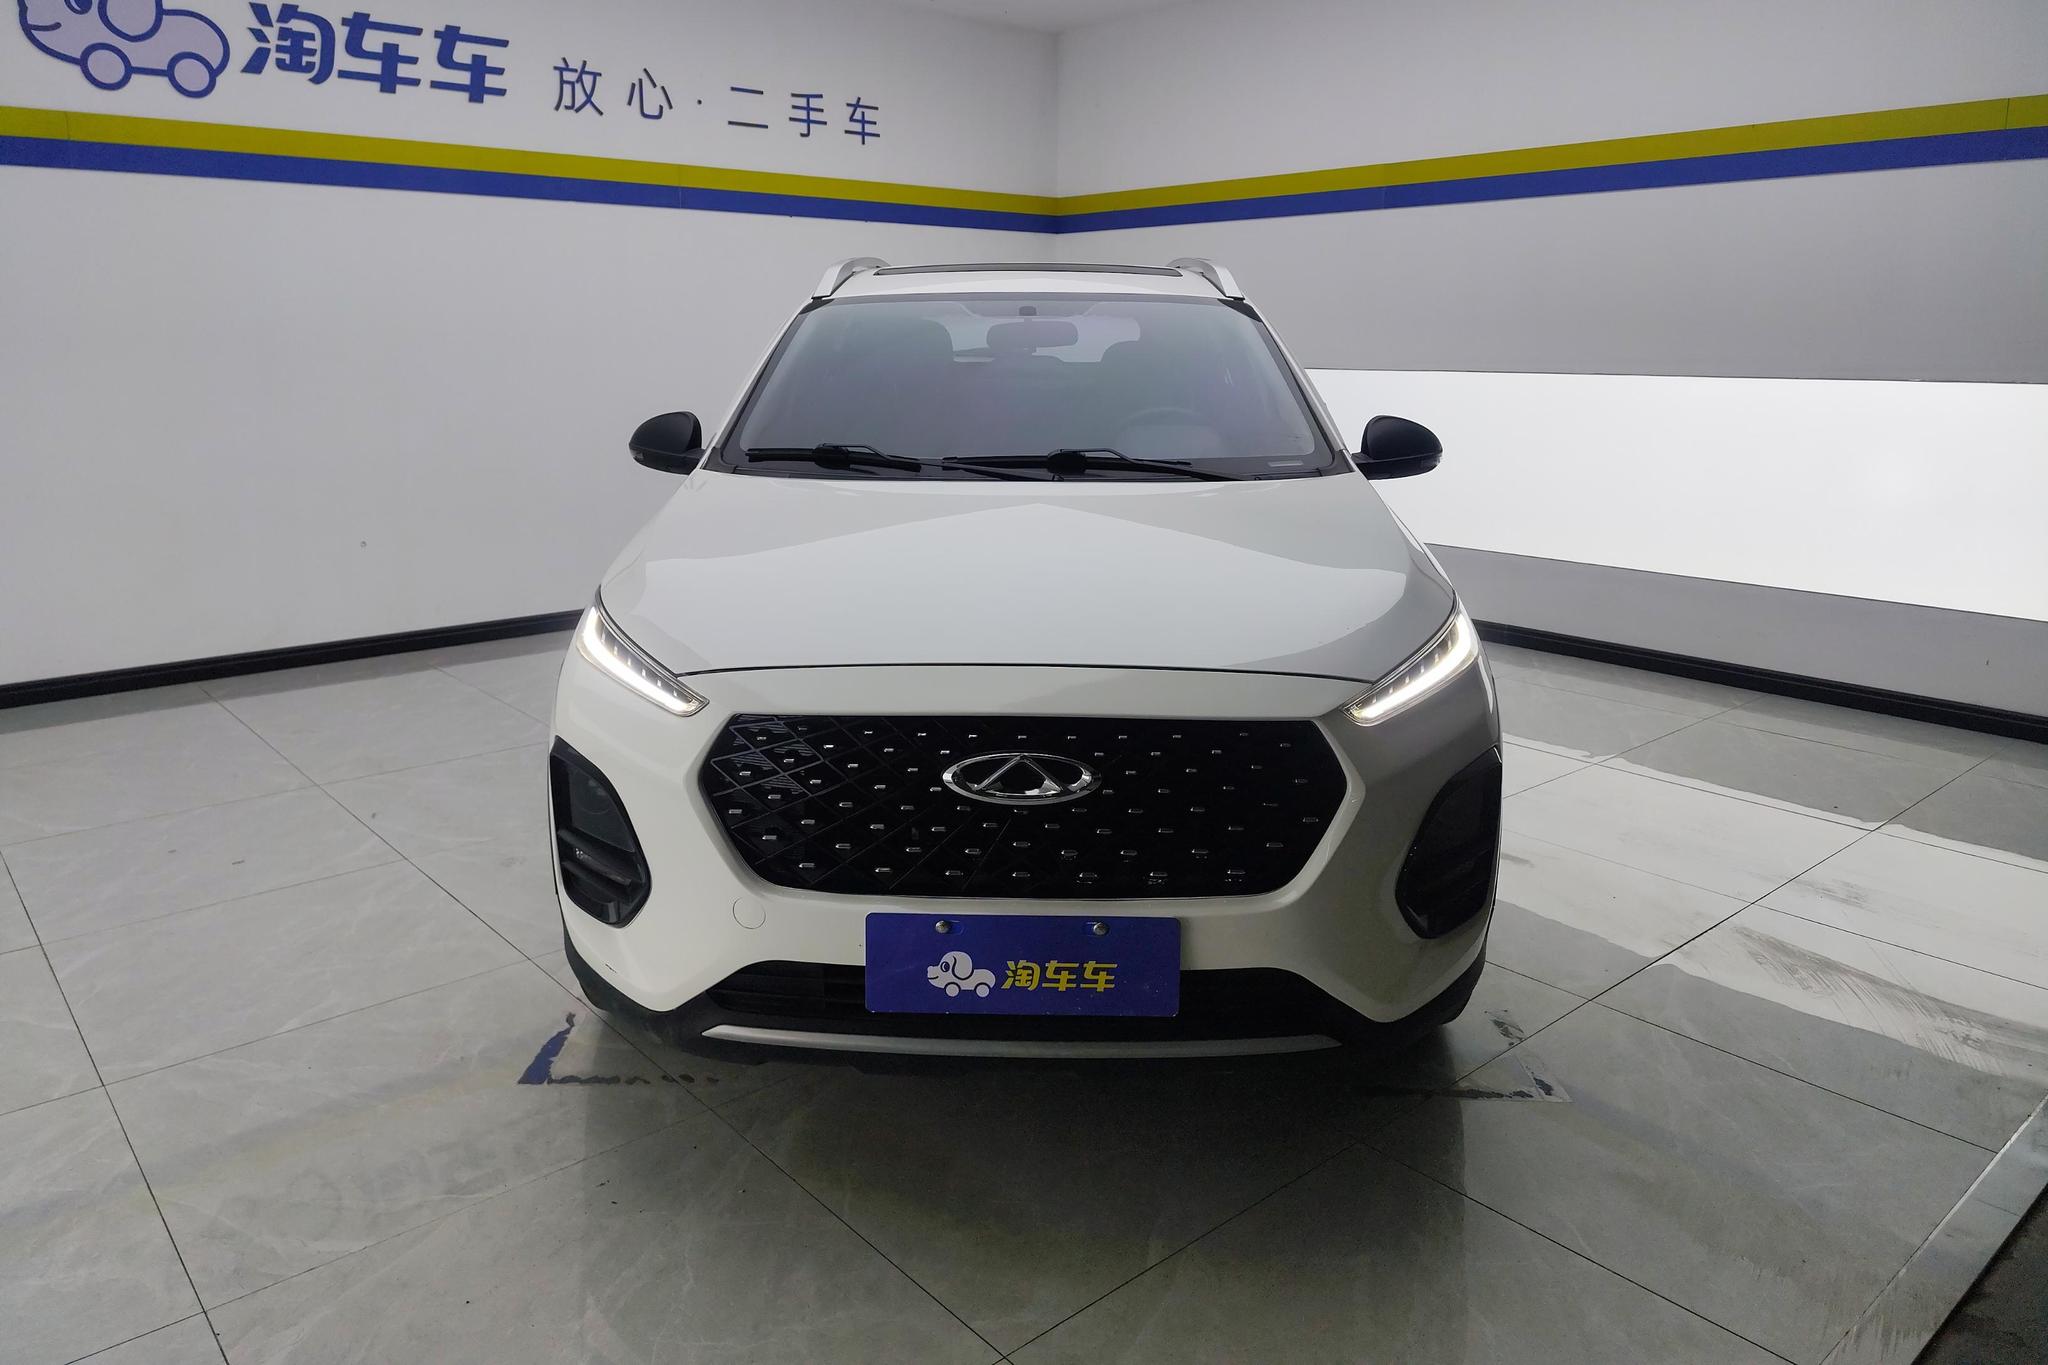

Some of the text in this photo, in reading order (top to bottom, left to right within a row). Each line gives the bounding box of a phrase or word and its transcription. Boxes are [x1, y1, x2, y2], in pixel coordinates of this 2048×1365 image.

[241, 2, 510, 104] 淘车车
[1001, 960, 1118, 992] 淘车车
